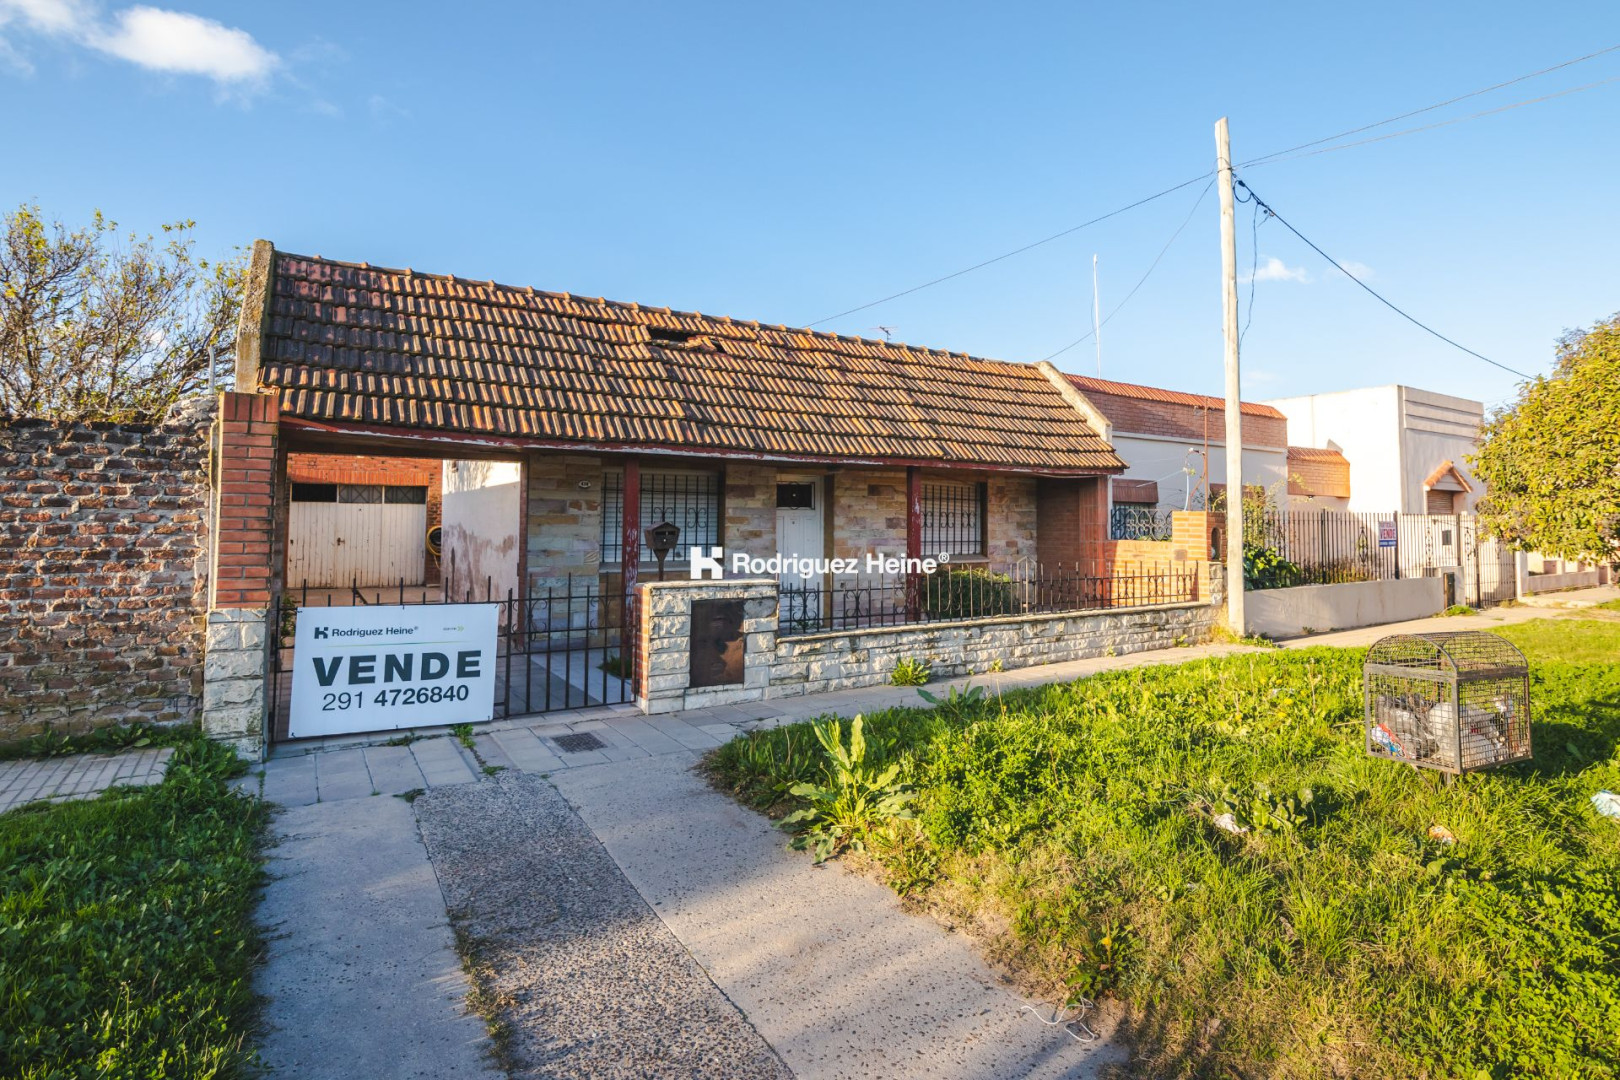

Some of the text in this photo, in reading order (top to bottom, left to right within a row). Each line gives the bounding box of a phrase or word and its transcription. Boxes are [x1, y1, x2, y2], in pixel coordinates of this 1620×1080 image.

[332, 627, 383, 637] Rodriguez
[312, 650, 482, 687] VENDE
[322, 684, 469, 711] 291 4726840
